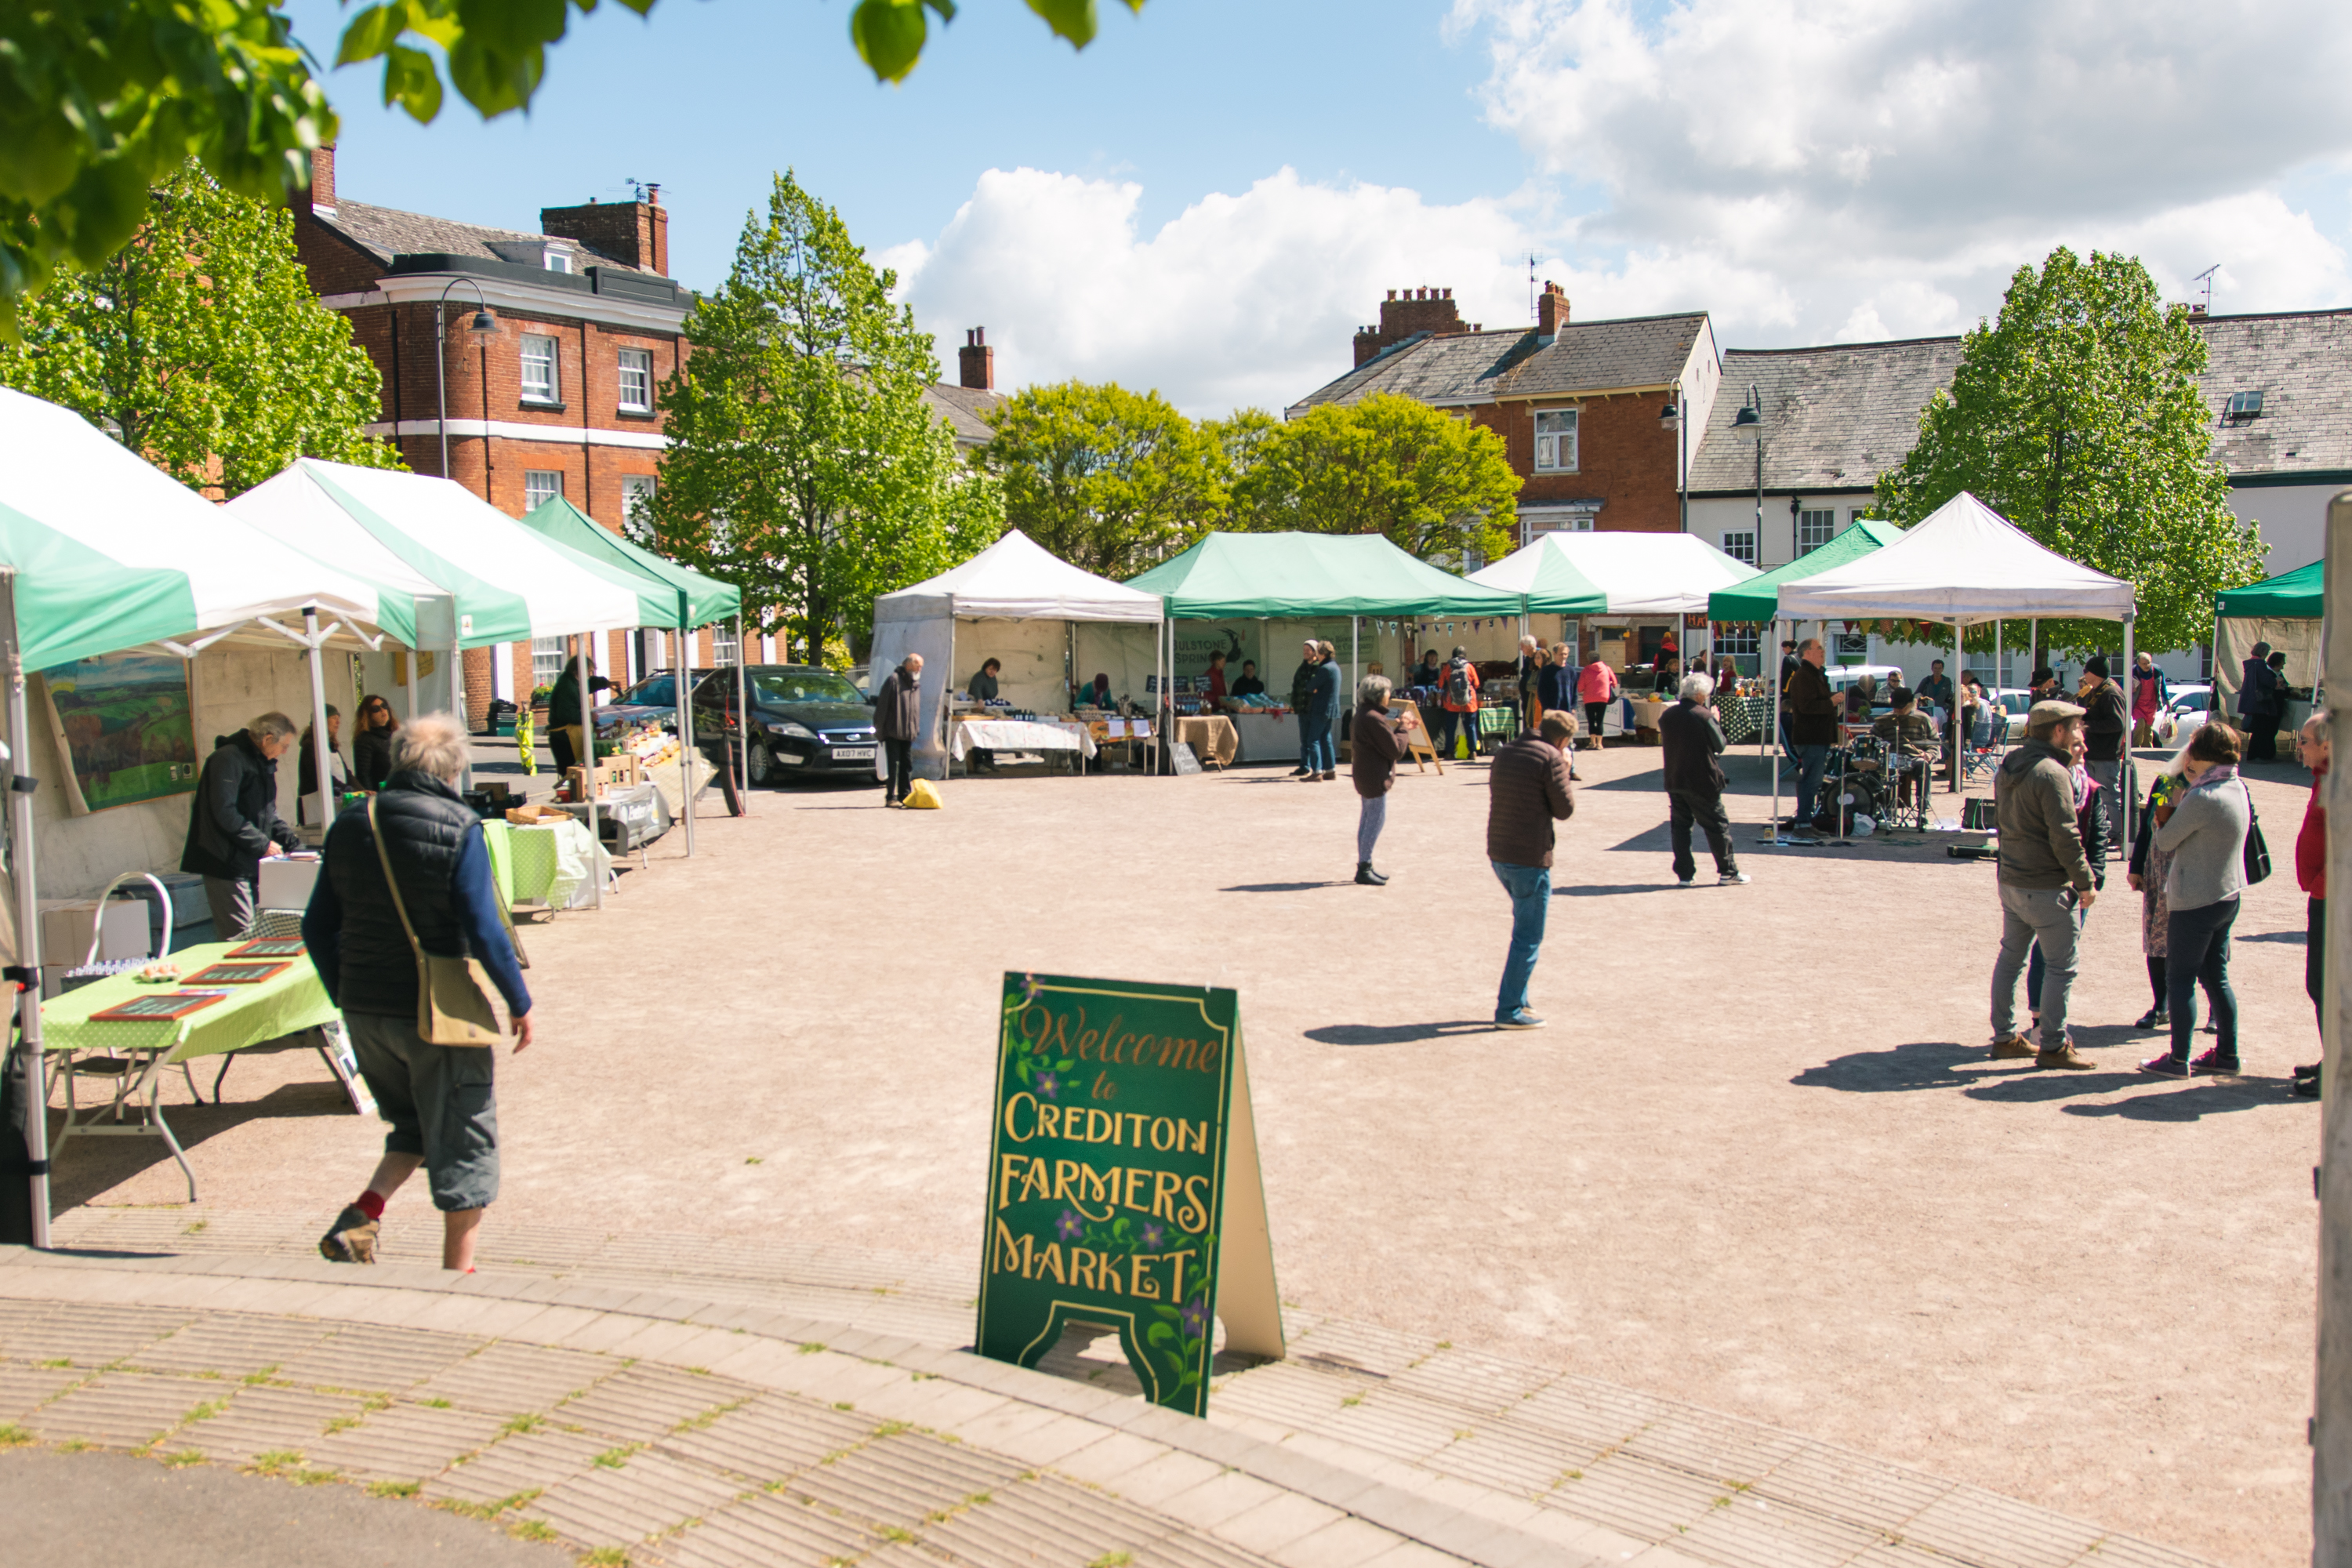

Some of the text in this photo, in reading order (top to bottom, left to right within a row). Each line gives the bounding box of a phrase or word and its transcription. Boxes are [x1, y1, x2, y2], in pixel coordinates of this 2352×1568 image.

[1174, 653, 1210, 664] SPRIN
[1021, 1004, 1218, 1073] Welcome
[1091, 1070, 1117, 1101] to
[1004, 1092, 1208, 1155] CREDITON
[999, 1153, 1210, 1234] FARMERS
[993, 1216, 1196, 1305] MARKET
